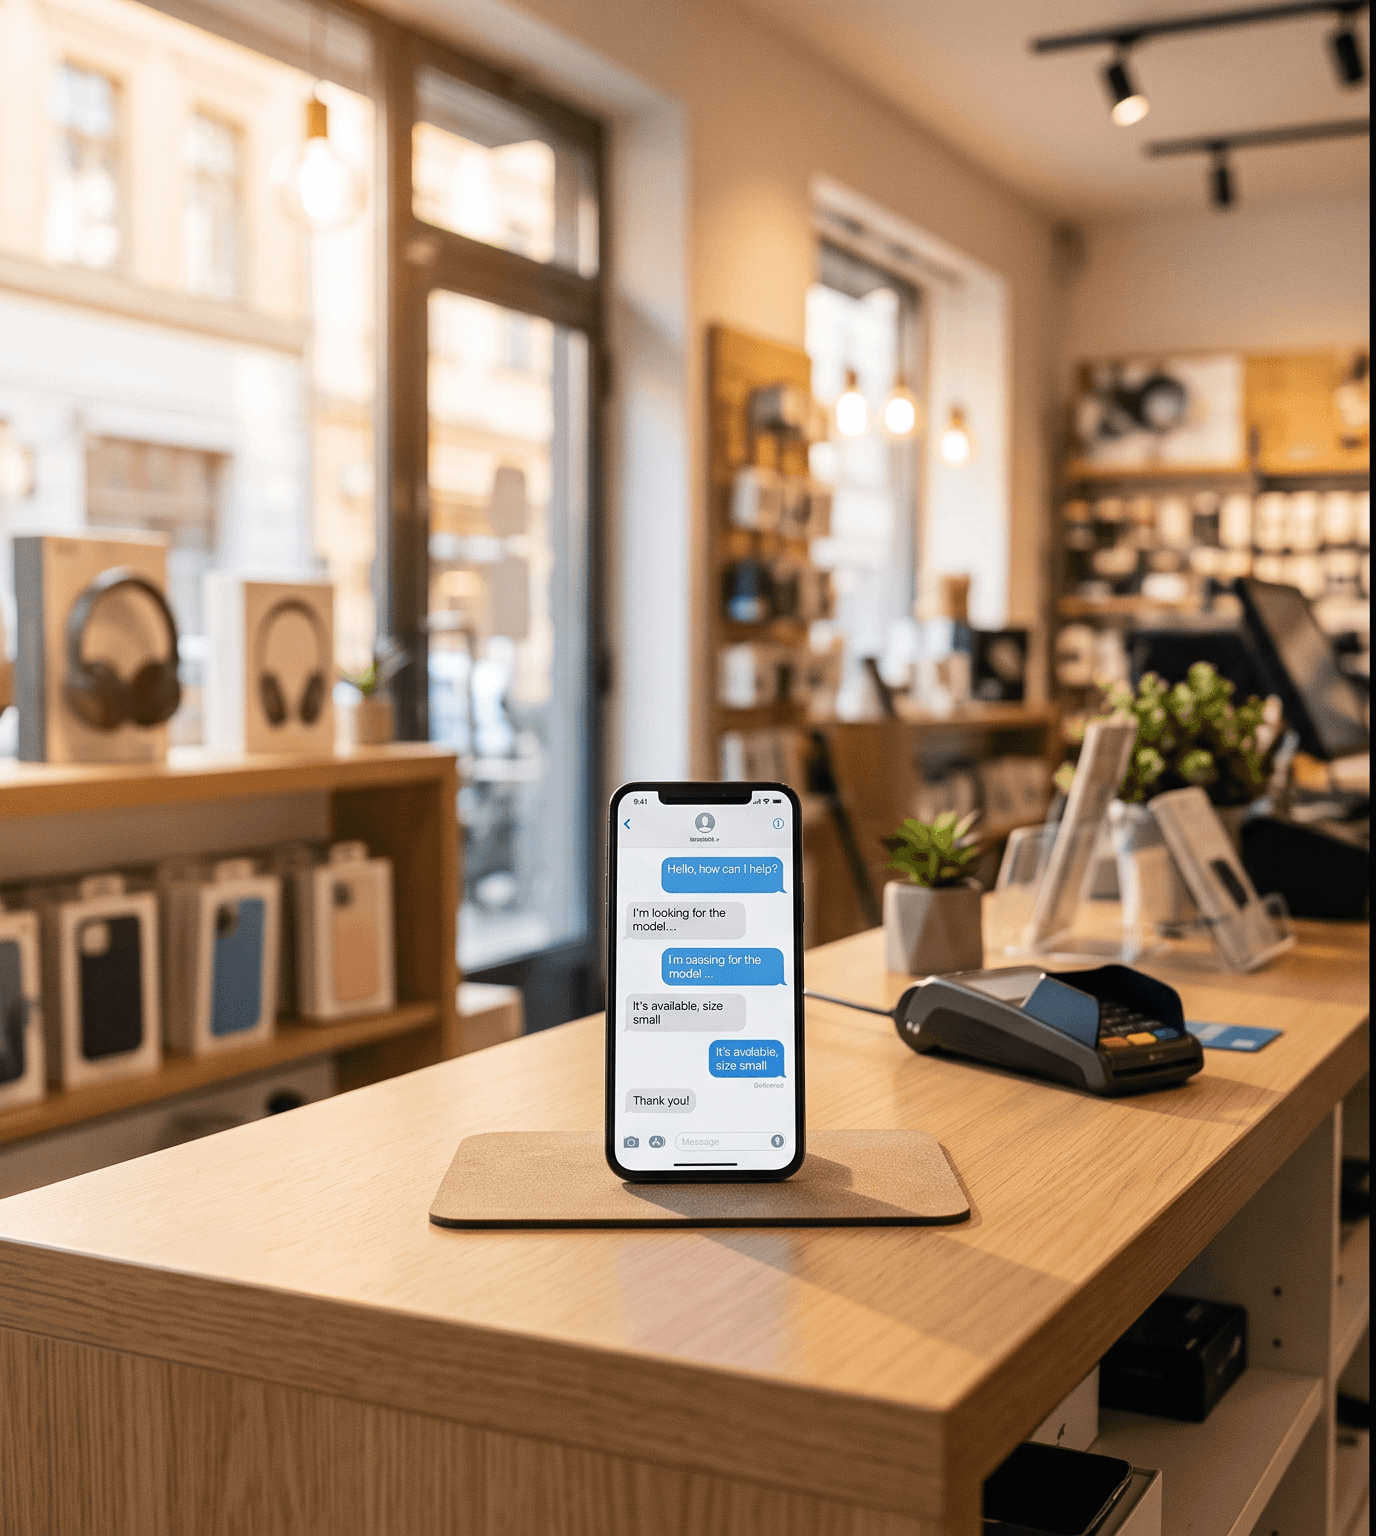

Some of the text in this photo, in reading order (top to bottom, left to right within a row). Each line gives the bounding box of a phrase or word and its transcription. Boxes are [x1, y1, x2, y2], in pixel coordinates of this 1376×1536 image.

[633, 798, 648, 806] 9:41
[667, 863, 778, 876] Hello, how can I help?
[632, 907, 726, 921] I'm looking for the
[728, 954, 742, 965] for
[744, 954, 761, 965] the
[669, 968, 702, 979] model
[632, 1001, 724, 1013] It's available, size
[632, 1014, 661, 1025] small
[716, 1046, 731, 1057] It's
[716, 1060, 767, 1071] size small
[633, 1095, 690, 1108] Thank you!
[681, 1138, 720, 1148] Message
